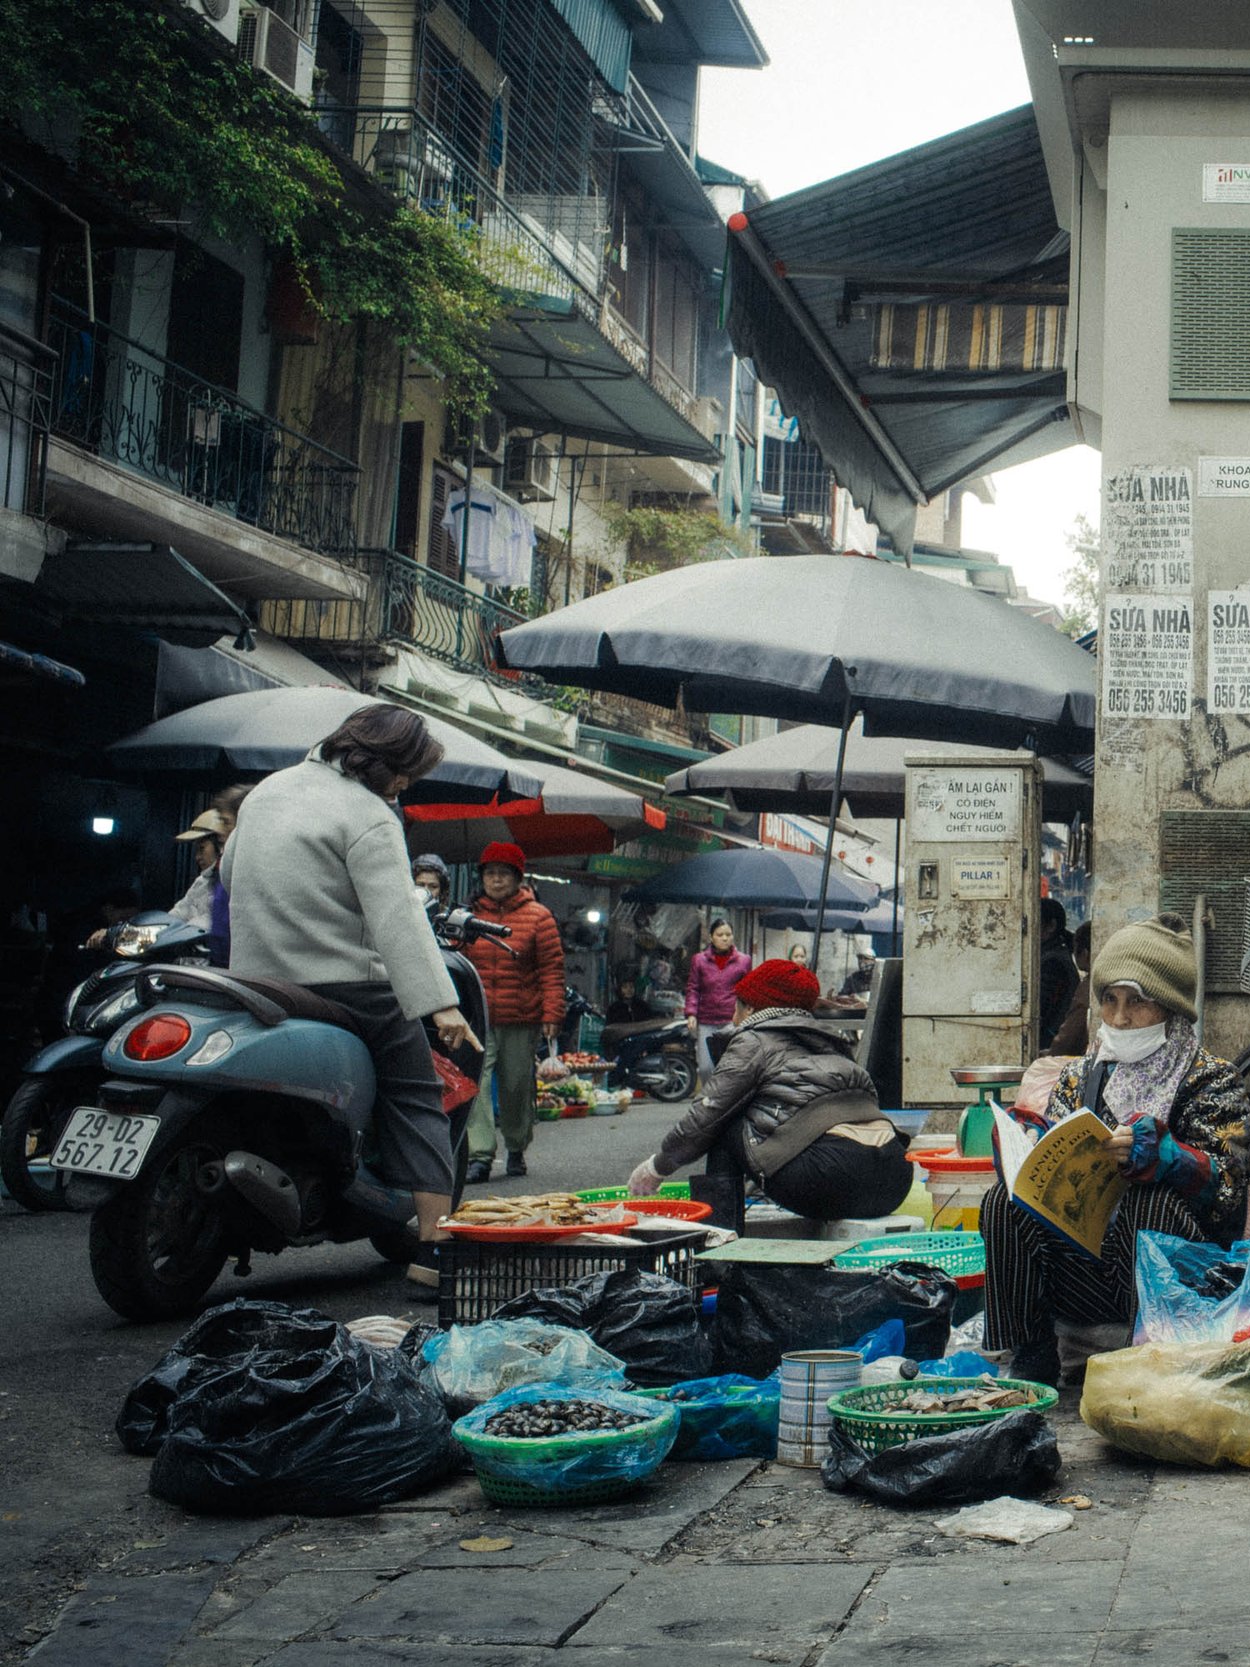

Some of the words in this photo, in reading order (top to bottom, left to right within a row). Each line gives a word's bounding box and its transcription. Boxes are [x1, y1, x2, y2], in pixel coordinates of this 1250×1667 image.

[1211, 479, 1250, 489] RUNG
[1142, 563, 1157, 586] 31
[1109, 598, 1146, 632] SỬA
[1153, 605, 1191, 633] NHÀ
[1212, 595, 1250, 629] SỬA
[1109, 688, 1130, 712] 056
[1133, 689, 1155, 713] 255
[1159, 689, 1188, 714] 3456
[1214, 684, 1235, 708] 056
[949, 811, 977, 820] NGUY
[961, 871, 993, 880] PILLAR
[76, 1113, 144, 1144] 29-D2
[56, 1140, 139, 1174] 567.12
